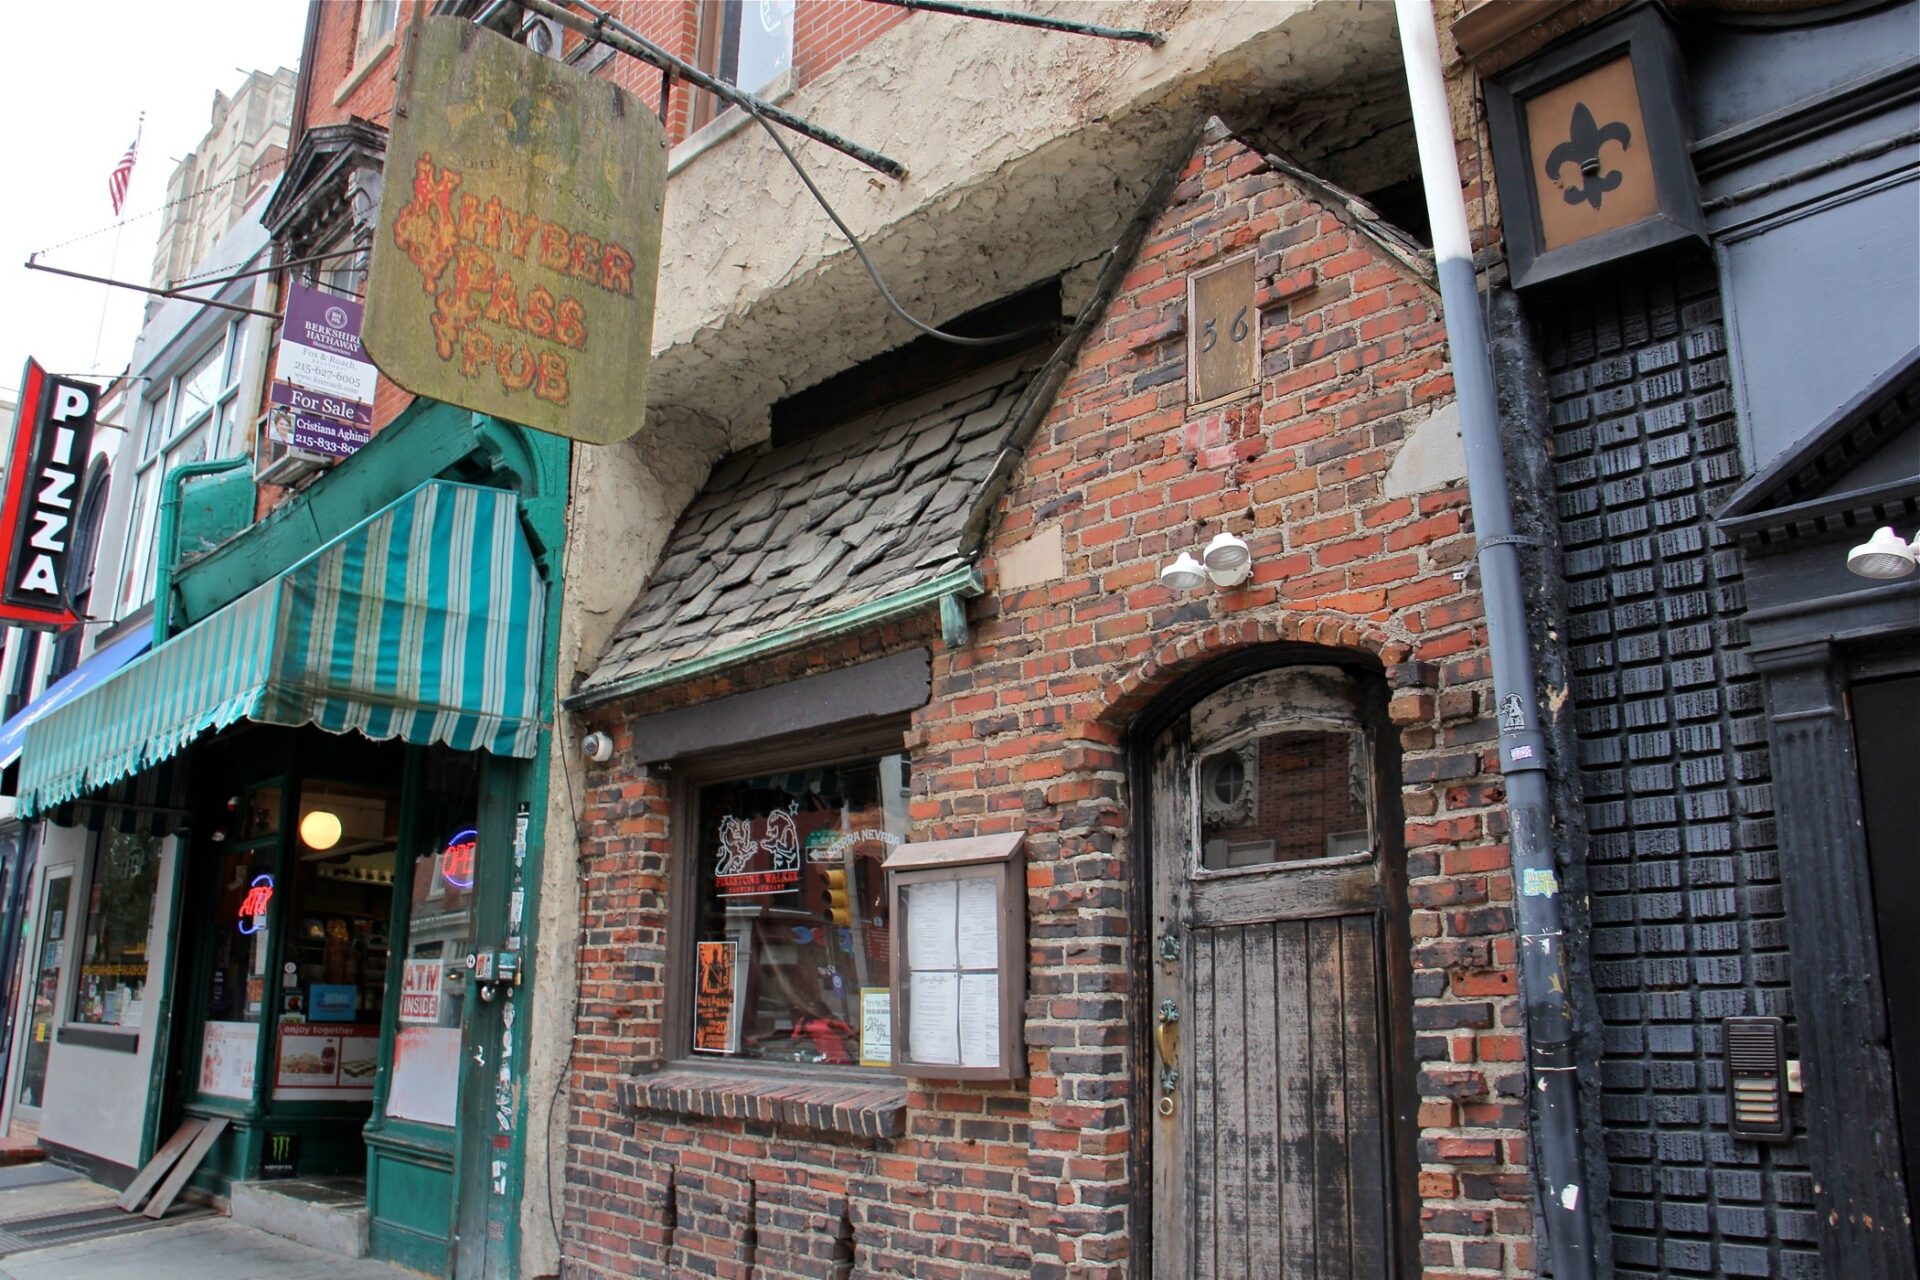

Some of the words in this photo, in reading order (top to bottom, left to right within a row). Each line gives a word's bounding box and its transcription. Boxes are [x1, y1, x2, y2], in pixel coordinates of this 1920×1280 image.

[394, 151, 636, 297] KHYBER
[431, 246, 587, 361] PASS
[306, 330, 360, 352] HATHAWAY
[1202, 305, 1249, 352] 56
[303, 348, 318, 359] Fox
[320, 353, 327, 361] &
[460, 327, 570, 406] PUB
[294, 361, 361, 387] 215-627-6005
[291, 390, 320, 410] For
[322, 398, 354, 419] Sale
[296, 418, 336, 436] Cristiana
[20, 384, 90, 595] PIZZA
[861, 828, 900, 846] NEVADA
[764, 871, 799, 884] WALKER
[403, 964, 441, 991] ATM
[403, 996, 436, 1015] INSIDE
[284, 1025, 310, 1035] enjoy
[313, 1026, 354, 1036] together
